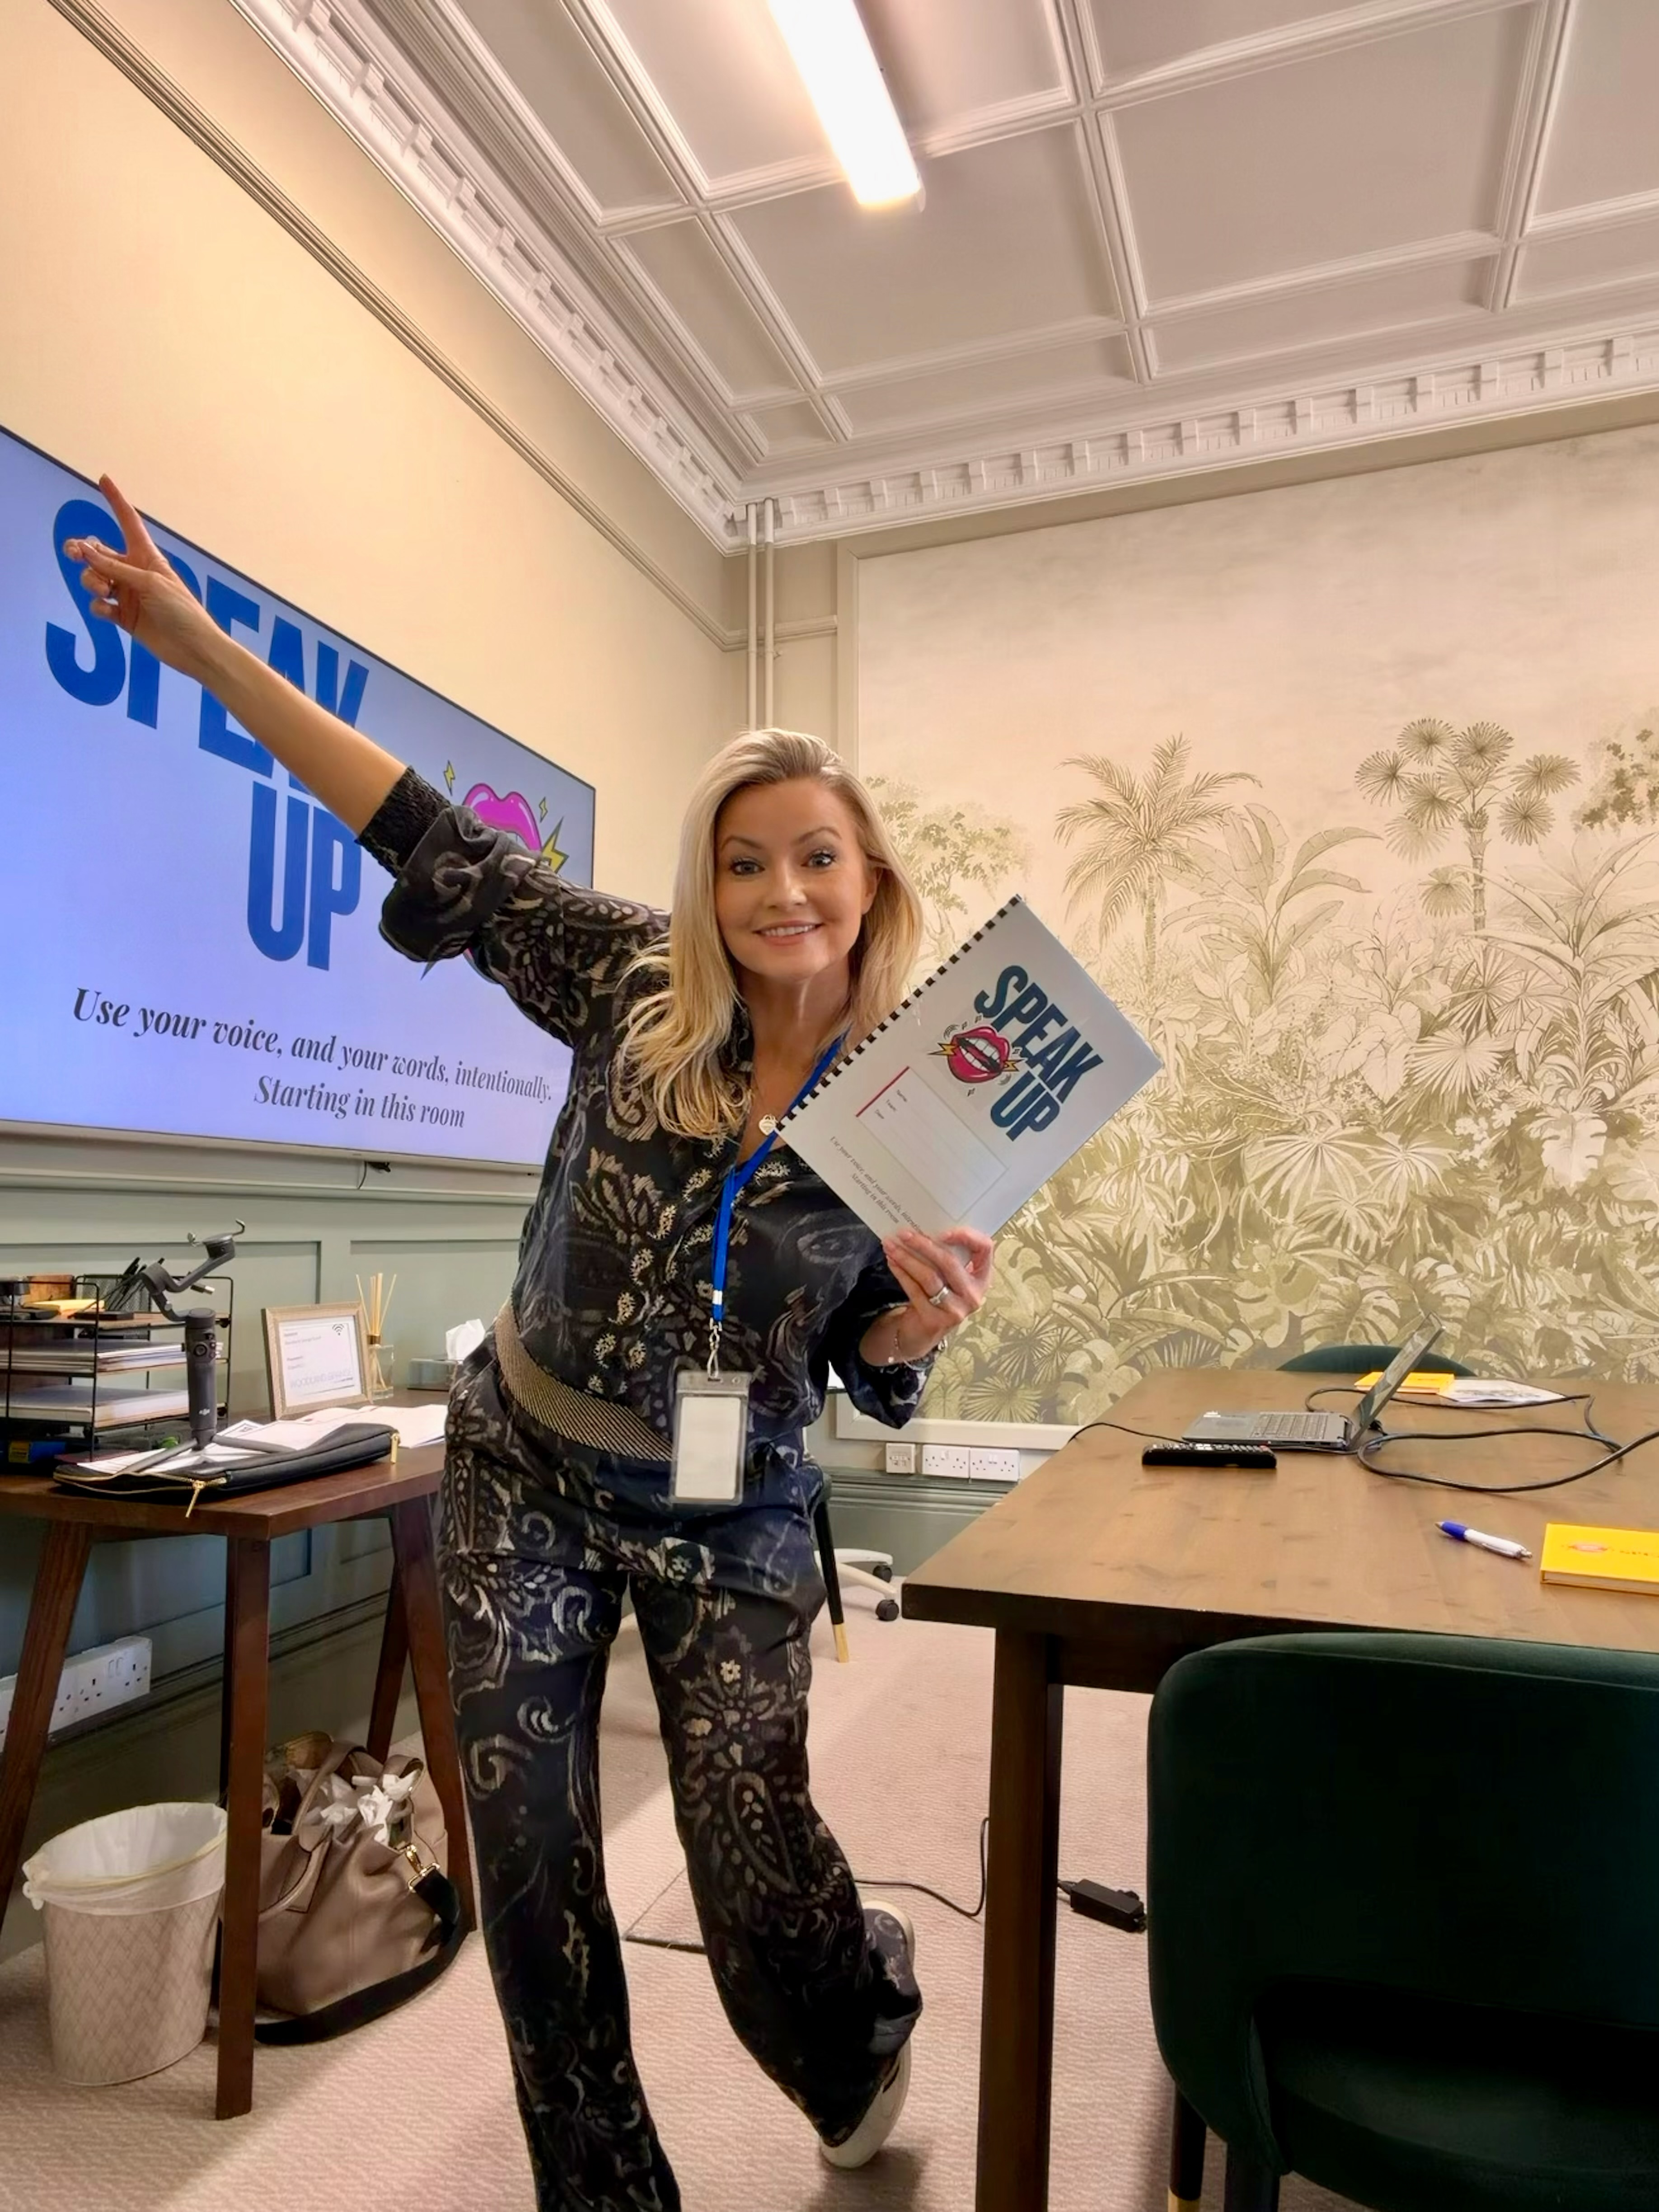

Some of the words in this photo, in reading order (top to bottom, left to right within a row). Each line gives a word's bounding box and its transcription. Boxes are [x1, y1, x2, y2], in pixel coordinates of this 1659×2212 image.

[247, 781, 361, 971] UP
[73, 987, 130, 1026] Use
[133, 1008, 206, 1039] your
[213, 1019, 282, 1058] voice,
[291, 1035, 337, 1063] and
[337, 1045, 389, 1071] your
[392, 1055, 449, 1086] words,
[455, 1061, 552, 1104] intentionally.
[974, 965, 1104, 1104] SPEAK
[254, 1075, 351, 1119] Starting
[354, 1088, 375, 1117] in
[380, 1092, 416, 1122] this
[420, 1103, 465, 1128] room
[990, 1070, 1060, 1142] UP
